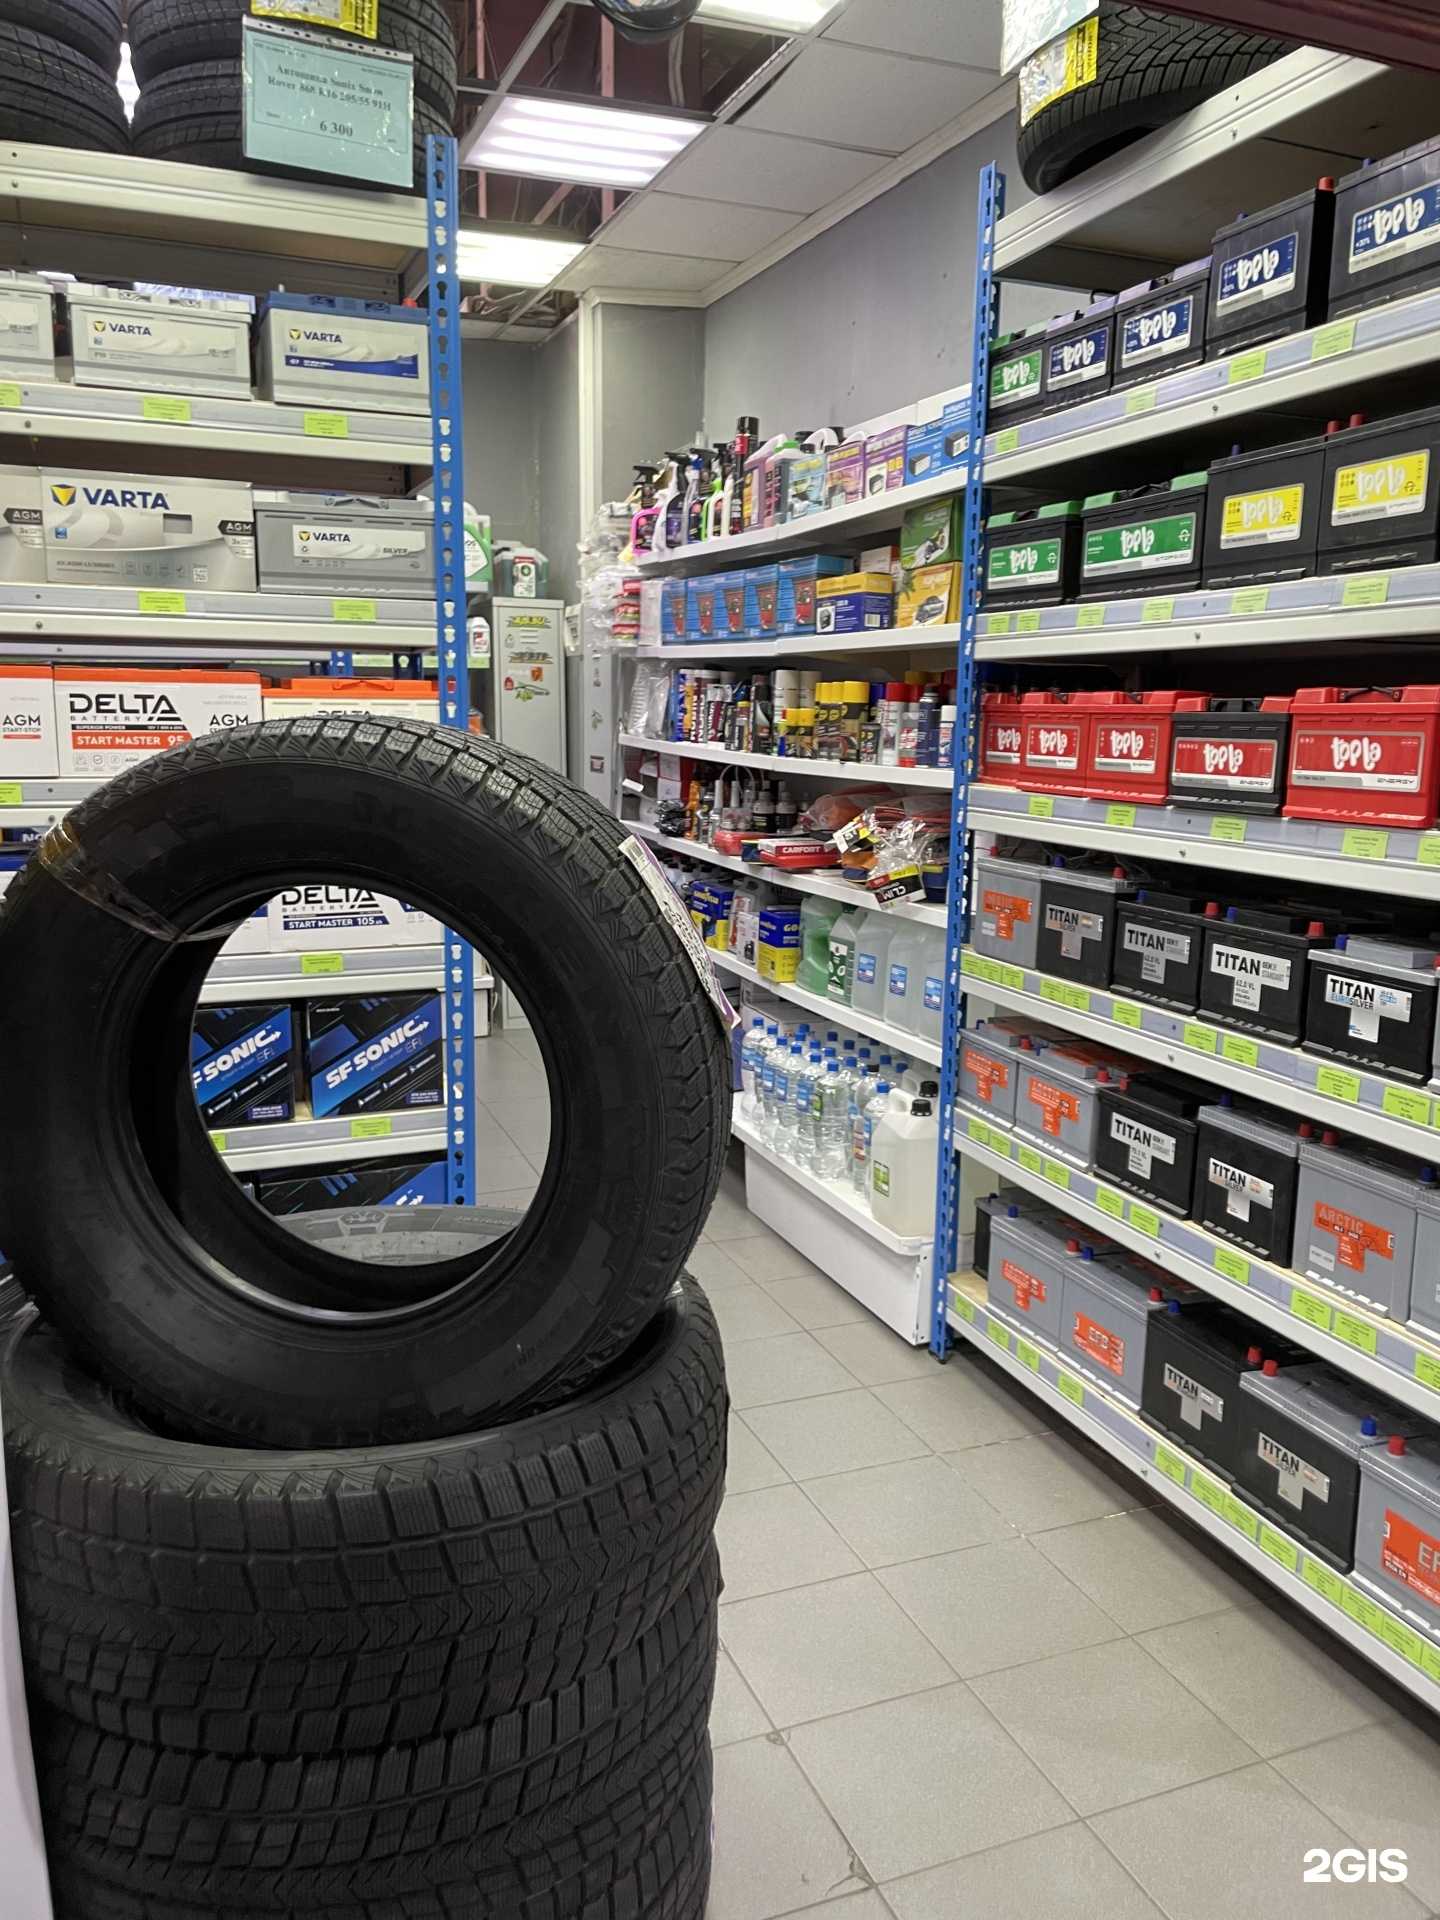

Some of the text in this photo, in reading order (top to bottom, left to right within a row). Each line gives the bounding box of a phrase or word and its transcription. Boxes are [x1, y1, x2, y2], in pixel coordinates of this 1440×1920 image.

[319, 120, 353, 137] 6 300
[1372, 197, 1425, 245] topla
[1235, 248, 1280, 290] topla
[109, 323, 152, 336] VARTA
[303, 331, 343, 343] VARTA
[1139, 310, 1177, 346] topla
[82, 487, 170, 510] VARTA
[12, 510, 41, 519] AGM
[225, 522, 252, 531] AGM
[313, 533, 351, 543] VARTA
[69, 693, 180, 715] DELTA
[2, 714, 41, 726] AGM
[209, 714, 249, 727] AGM
[77, 735, 112, 745] START
[115, 735, 161, 746] MASTER
[1039, 729, 1068, 755] topla
[1110, 729, 1144, 757] topla
[1203, 743, 1243, 773] topla
[1330, 736, 1382, 771] topla
[282, 885, 378, 906] DELTA
[288, 920, 316, 929] START
[318, 919, 353, 928] MASTER
[357, 917, 375, 926] 105
[1048, 907, 1079, 926] TITAN
[1127, 929, 1165, 952] TITAN
[1216, 950, 1261, 976] TITAN
[1330, 978, 1375, 1002] TITAN
[202, 1029, 282, 1082] SONIC
[325, 1019, 430, 1089] SF SONIC
[1114, 1119, 1151, 1148] TITAN
[1212, 1162, 1247, 1187] TITAN
[1319, 1206, 1364, 1234] ARCTIC
[1167, 1368, 1198, 1398] TITAN
[1261, 1436, 1300, 1473] TITAN
